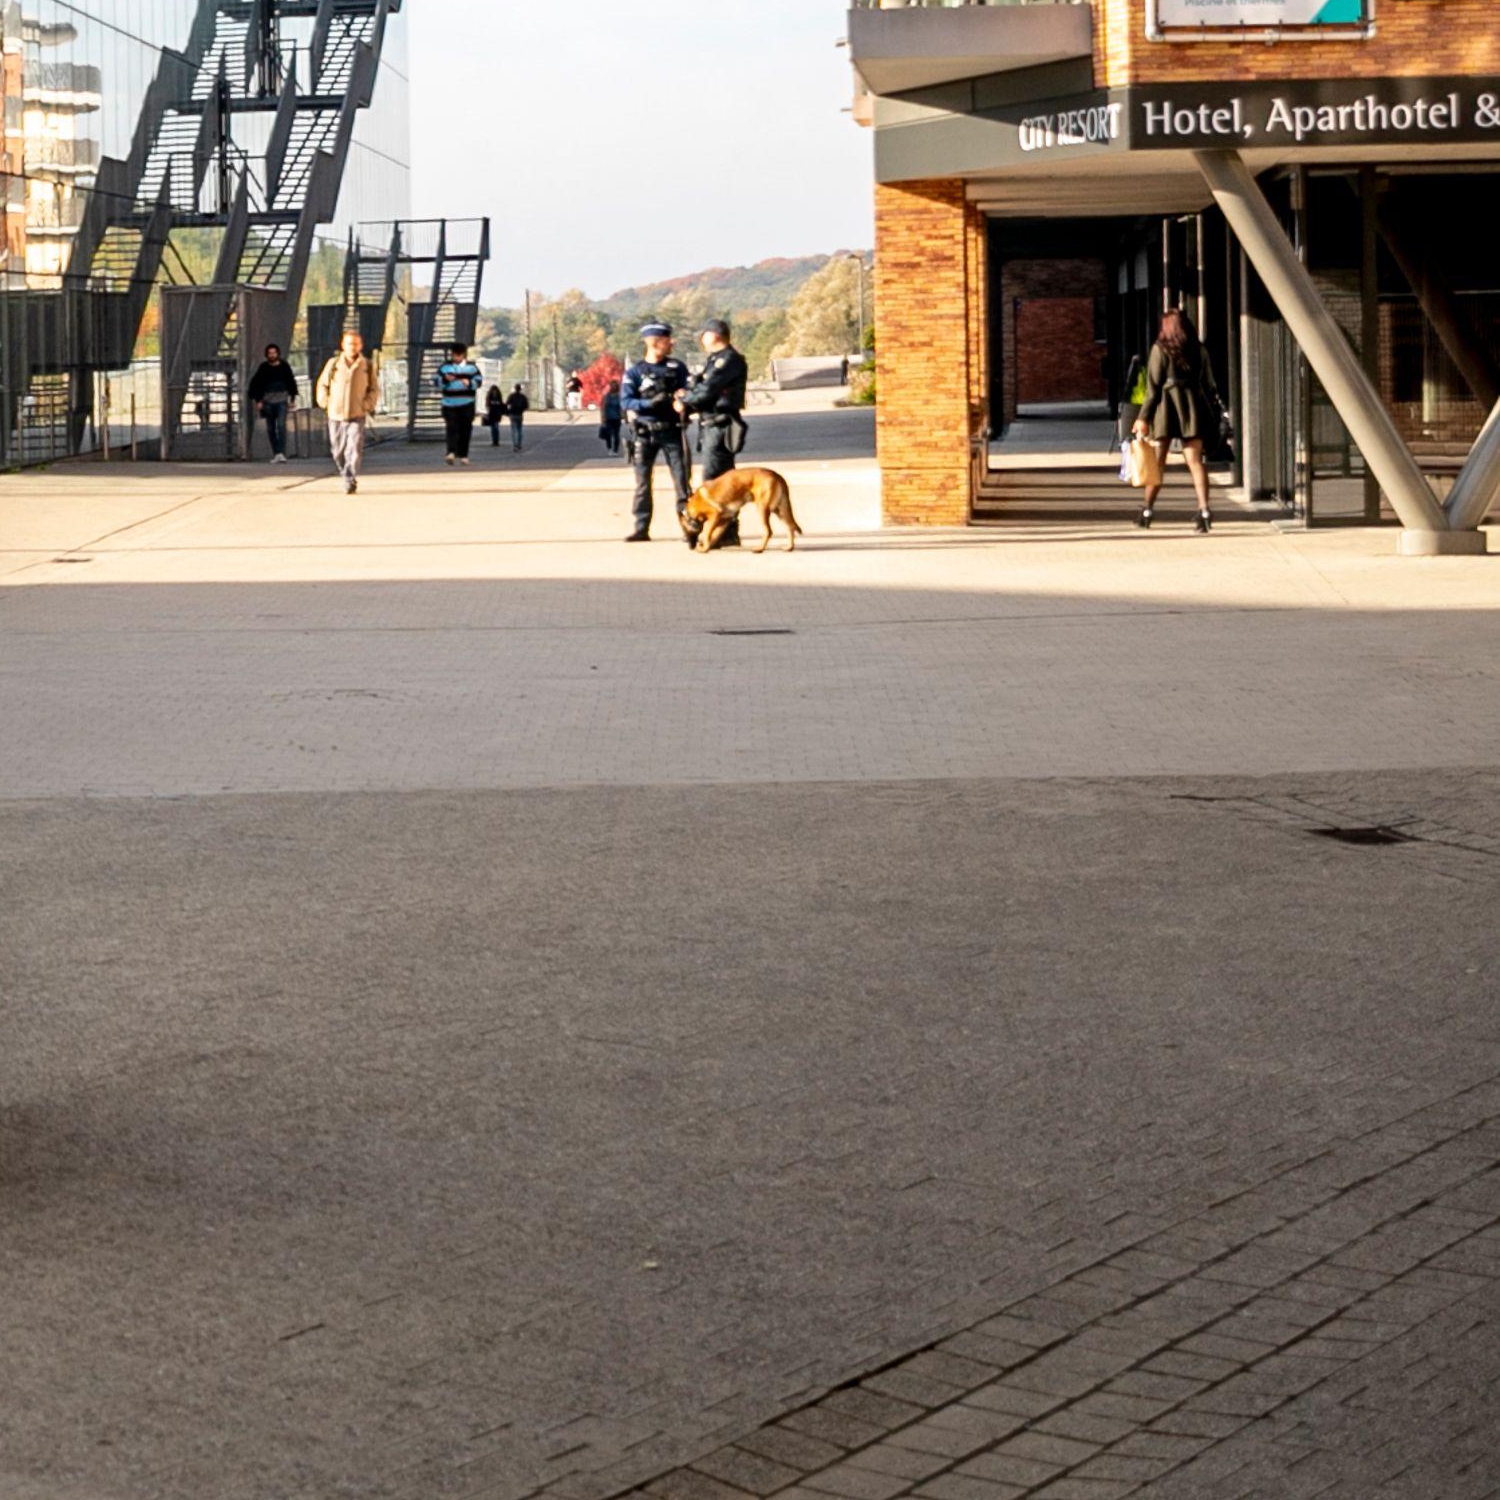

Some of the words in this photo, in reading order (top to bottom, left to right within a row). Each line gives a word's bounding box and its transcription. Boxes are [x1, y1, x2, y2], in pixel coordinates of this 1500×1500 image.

[1018, 115, 1054, 152] CITY
[1056, 102, 1123, 146] RESORT
[1142, 98, 1253, 140] Hotel,
[1265, 92, 1459, 141] Aparthotel
[1474, 92, 1500, 128] &
